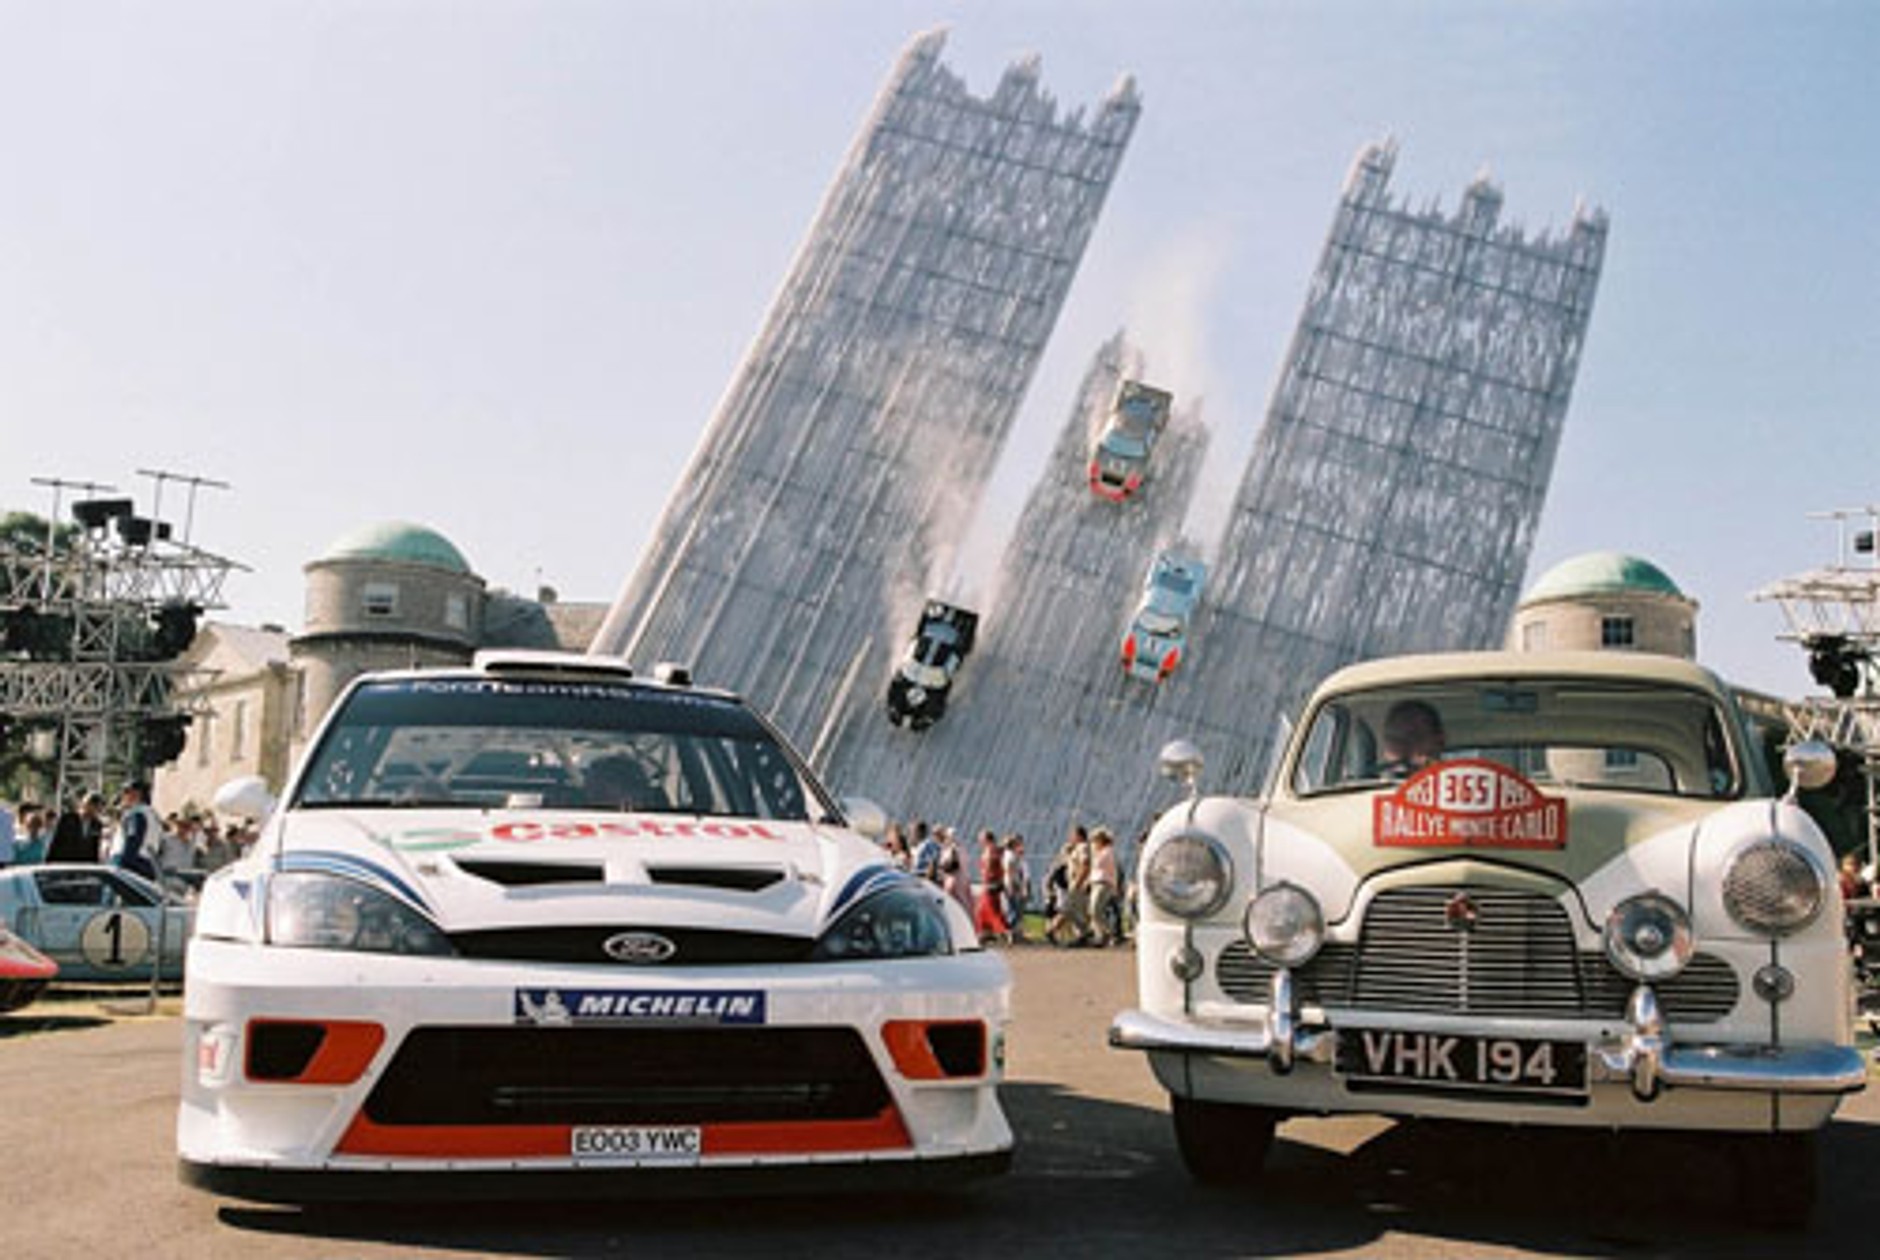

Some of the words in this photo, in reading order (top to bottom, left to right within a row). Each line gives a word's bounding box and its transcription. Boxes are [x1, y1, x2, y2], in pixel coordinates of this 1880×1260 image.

[1446, 775, 1490, 804] 365
[492, 821, 784, 842] Castrol
[1382, 802, 1445, 837] RALLYE
[103, 913, 124, 963] 1
[578, 996, 754, 1016] MICHELIN
[1363, 1031, 1458, 1078] VHK
[1477, 1040, 1555, 1084] 194
[644, 1130, 697, 1150] YWC
